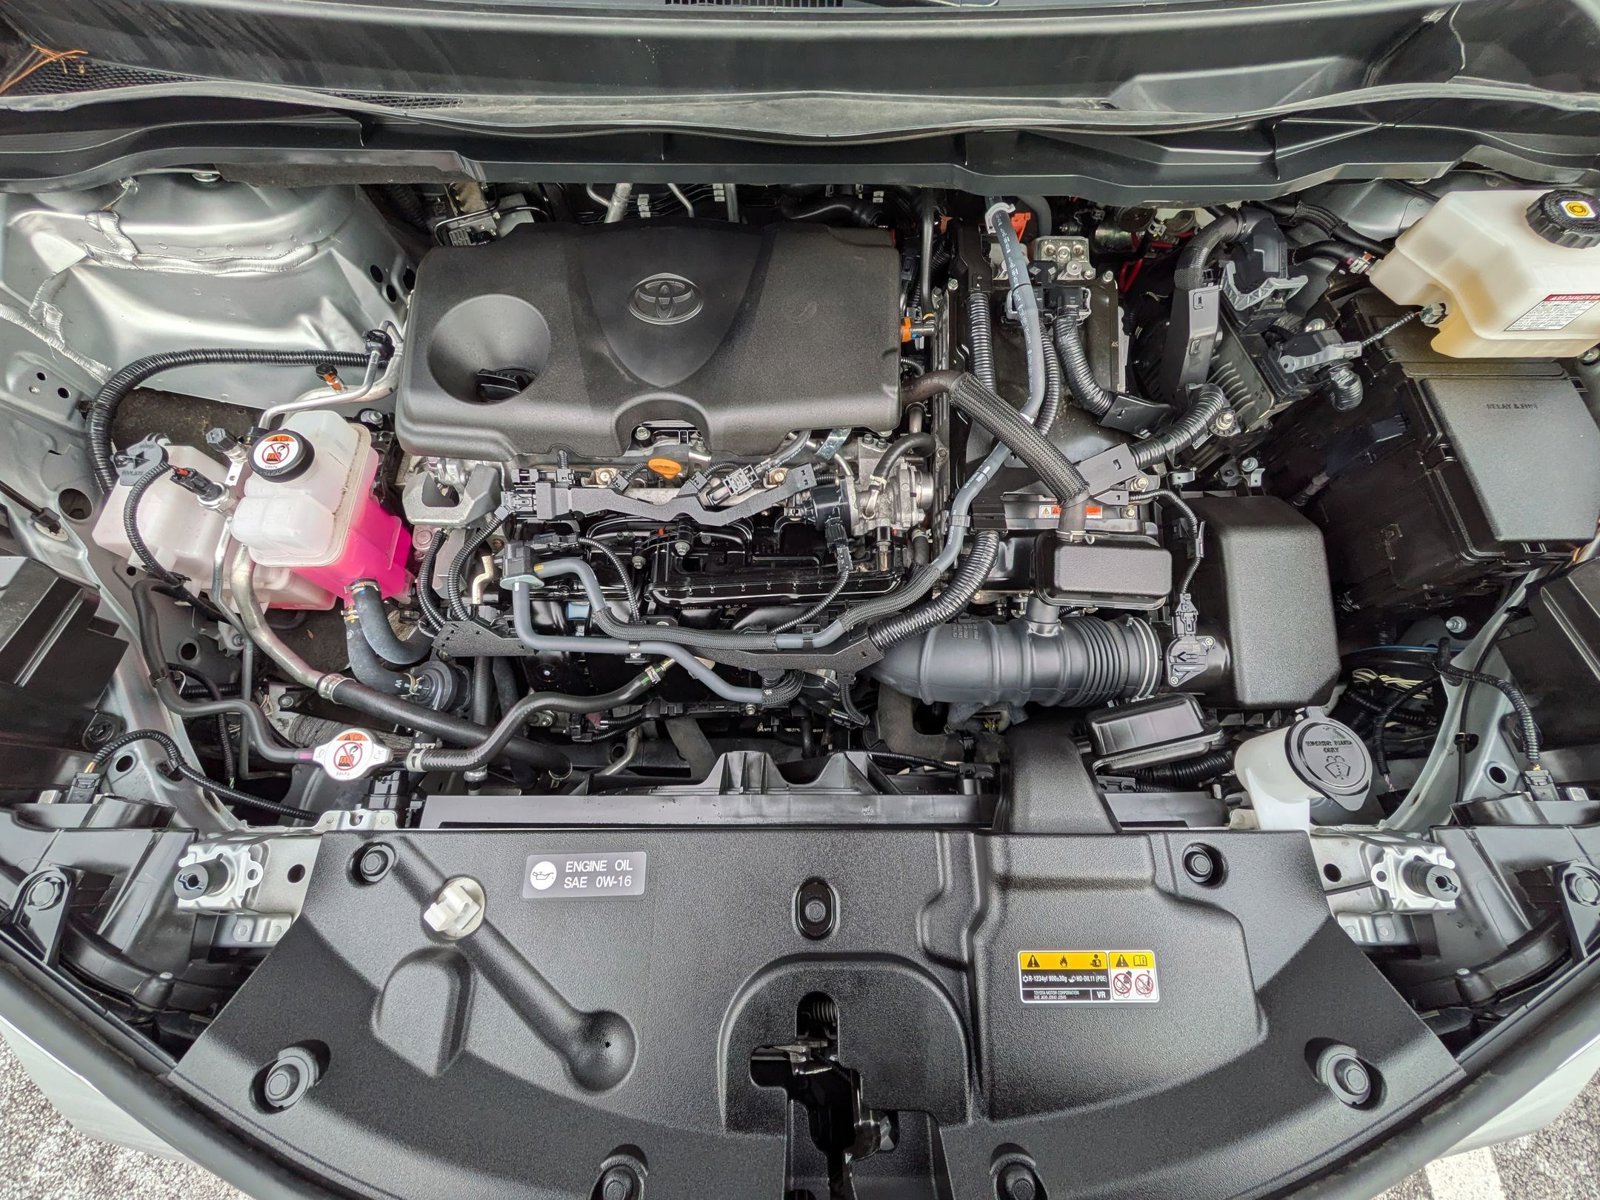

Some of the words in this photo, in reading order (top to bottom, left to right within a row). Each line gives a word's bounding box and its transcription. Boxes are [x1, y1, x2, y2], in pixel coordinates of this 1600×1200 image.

[565, 860, 607, 873] ENGINE
[614, 859, 633, 871] OIL
[563, 876, 588, 889] SAE
[595, 875, 632, 888] 0W-16
[1096, 991, 1107, 999] VR
